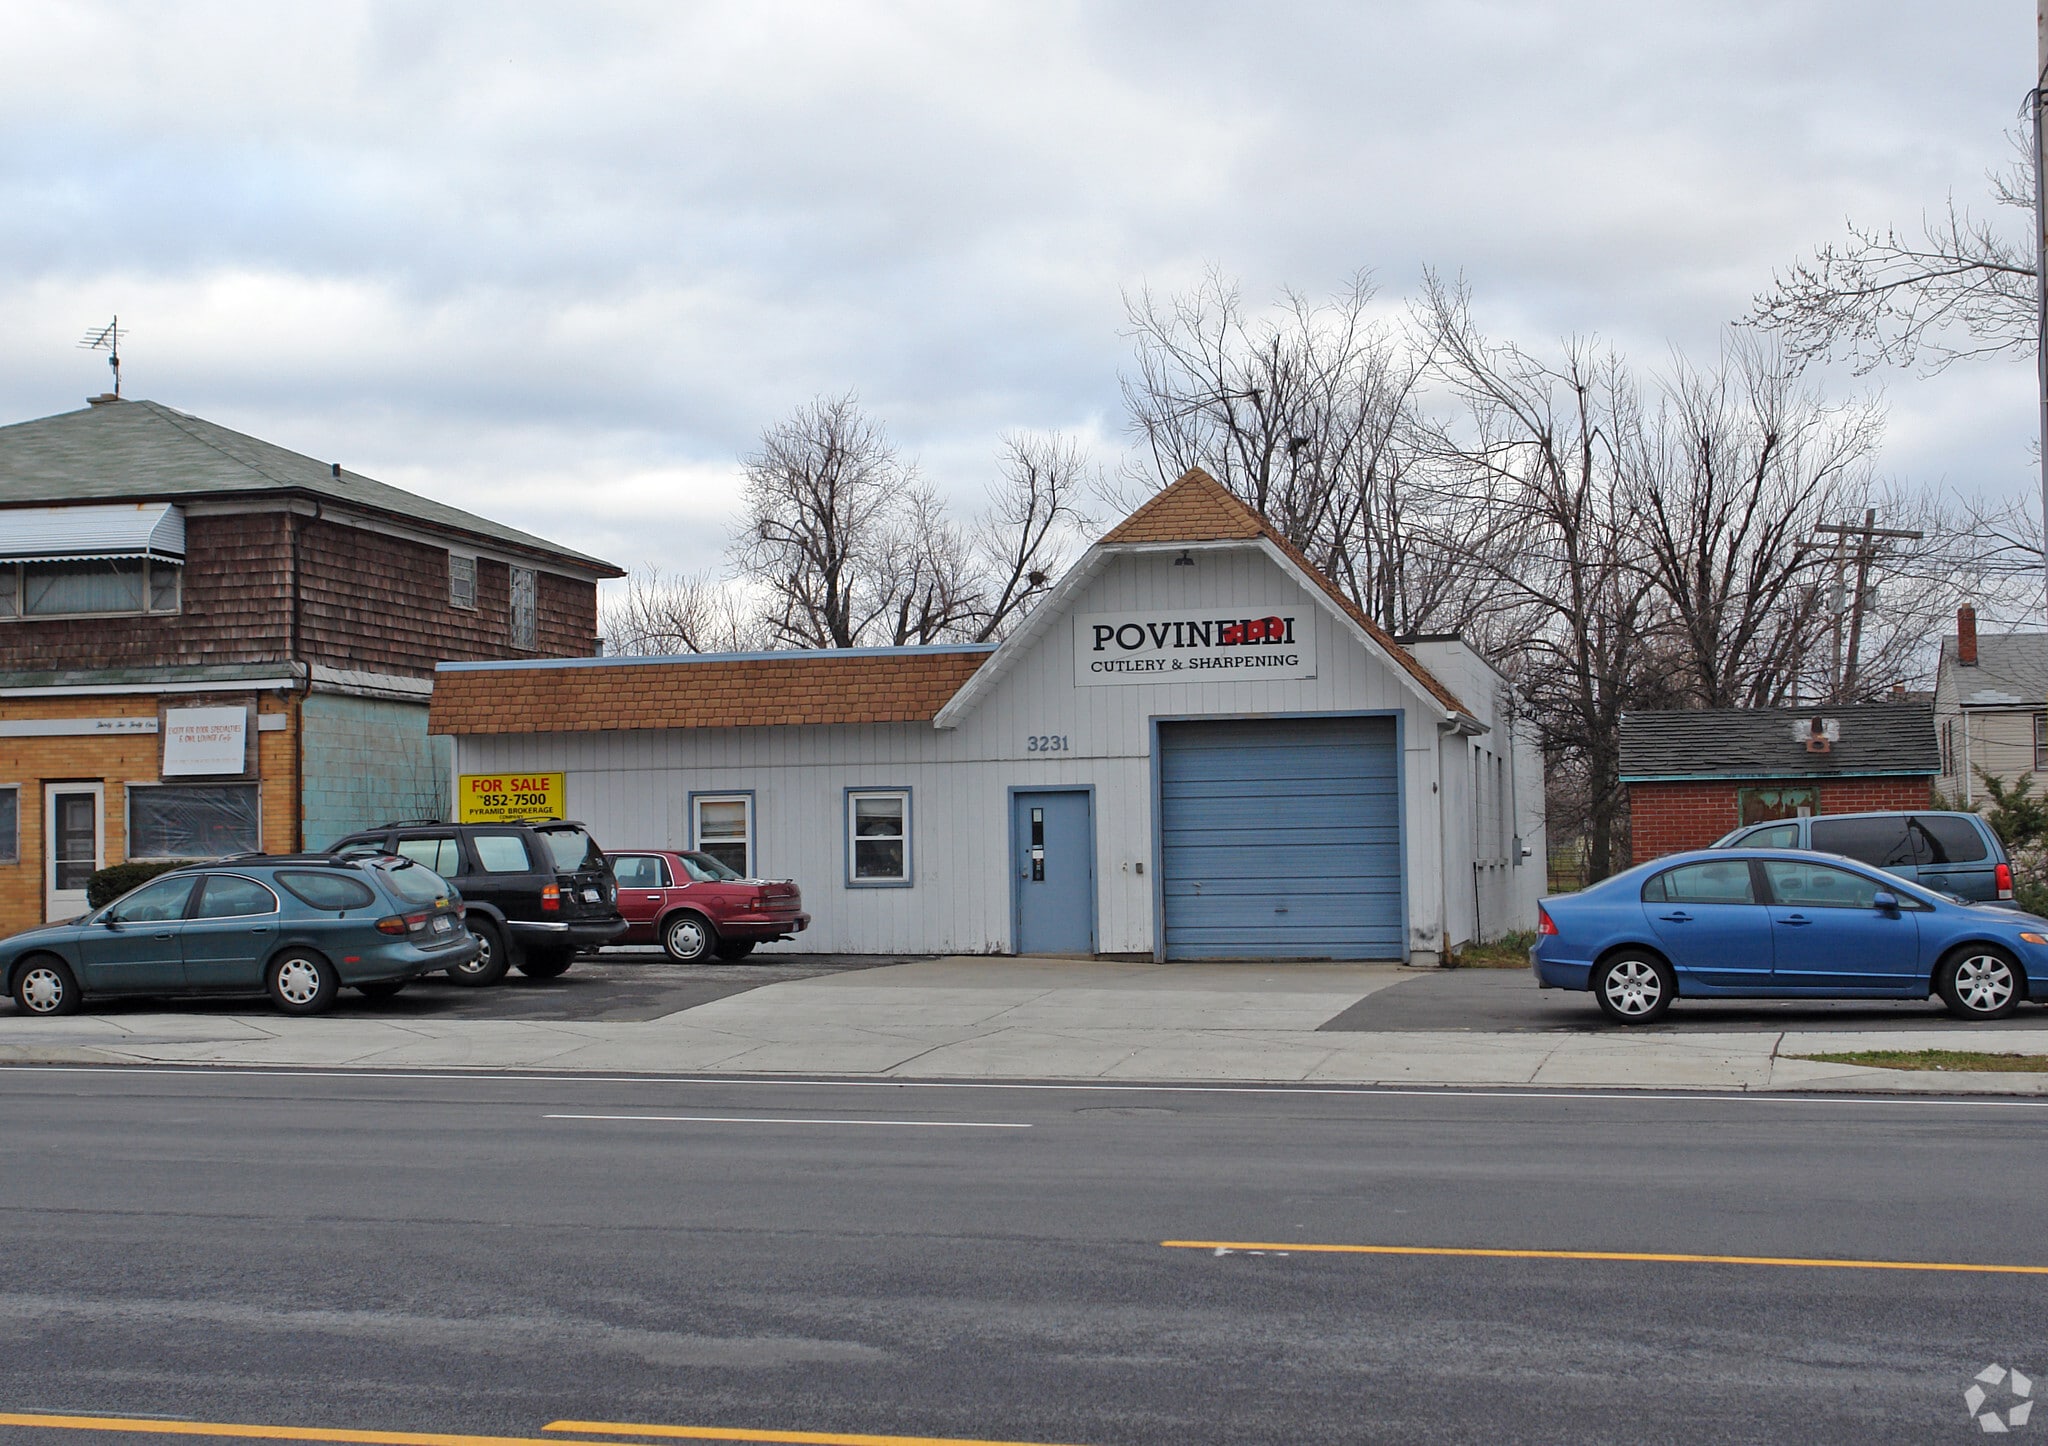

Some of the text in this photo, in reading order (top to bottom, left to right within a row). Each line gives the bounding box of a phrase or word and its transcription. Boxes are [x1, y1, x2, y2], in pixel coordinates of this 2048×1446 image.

[1092, 617, 1296, 651] POVINELLI
[1091, 654, 1300, 673] CUTLERY & SHARPENING
[1027, 735, 1069, 751] 3231
[472, 778, 550, 792] FOR SALE
[508, 806, 553, 815] BROKERAGE
